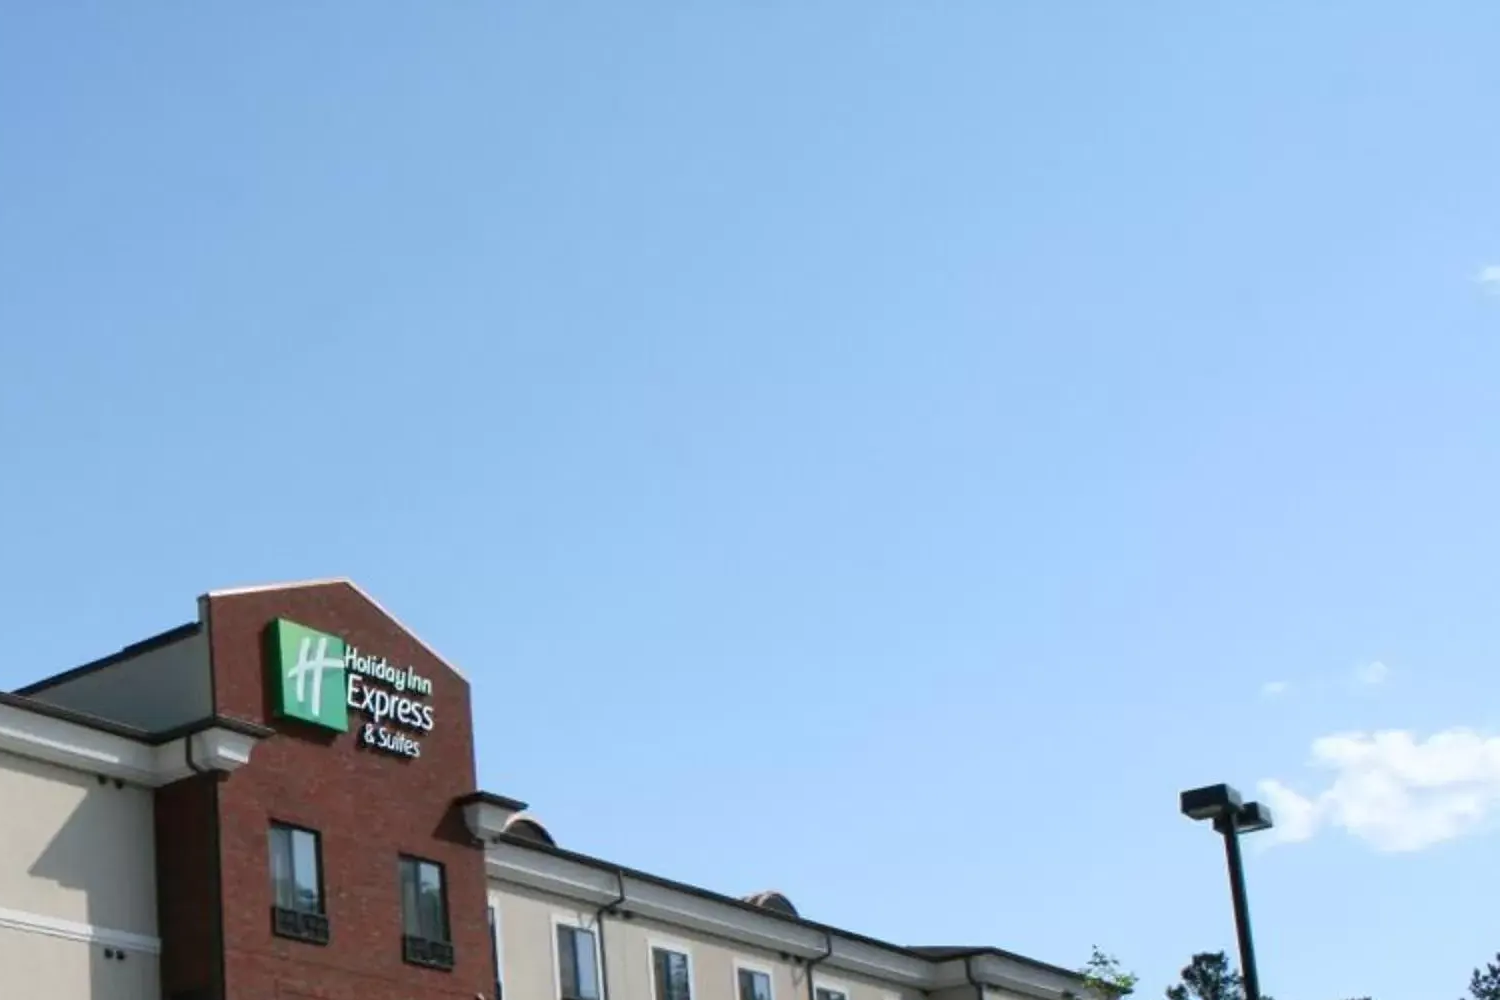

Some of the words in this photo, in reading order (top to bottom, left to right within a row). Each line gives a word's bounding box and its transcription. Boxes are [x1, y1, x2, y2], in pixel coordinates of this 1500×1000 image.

[345, 644, 406, 691] Holiday
[407, 665, 432, 695] Inn
[347, 674, 434, 731] Express
[364, 723, 375, 744] &
[378, 727, 420, 758] Suites
